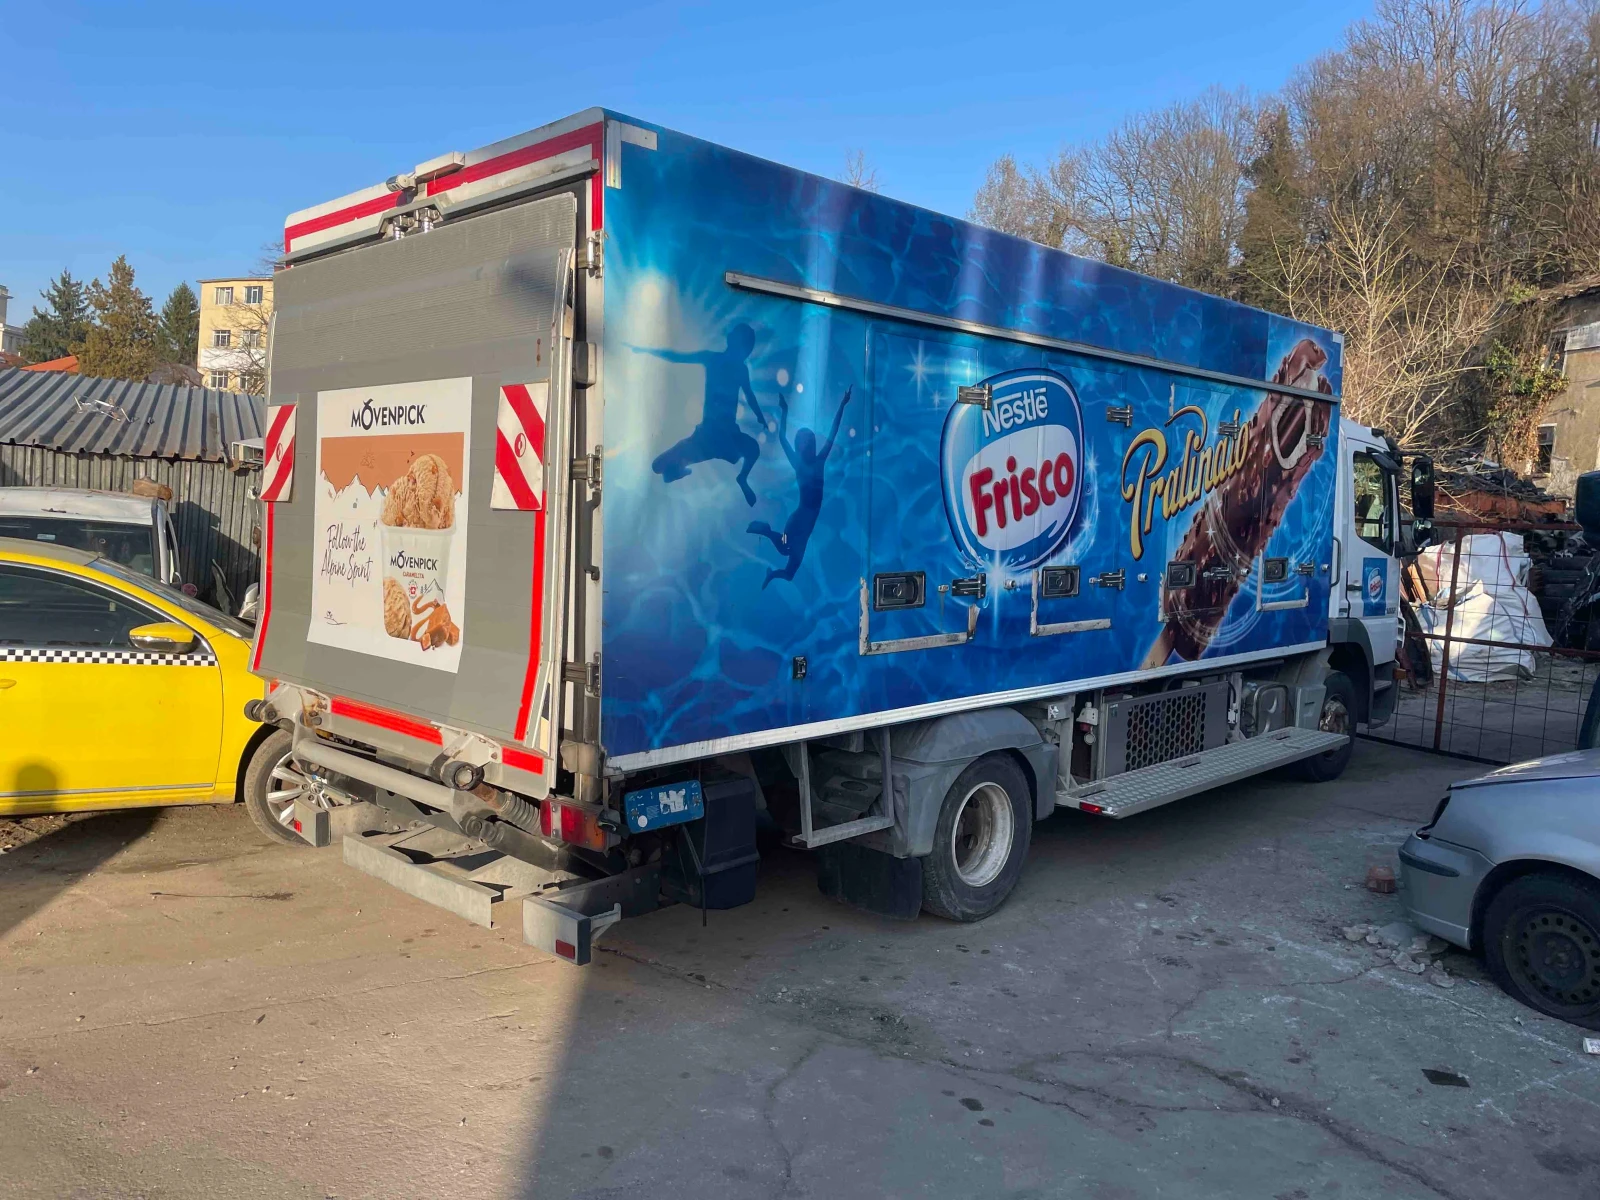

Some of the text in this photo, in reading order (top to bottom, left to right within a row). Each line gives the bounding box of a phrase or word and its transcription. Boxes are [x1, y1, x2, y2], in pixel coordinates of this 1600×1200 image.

[970, 452, 1074, 537] Frisco
[1121, 405, 1249, 560] Pralinato
[321, 549, 373, 588] Alpine Spirit
